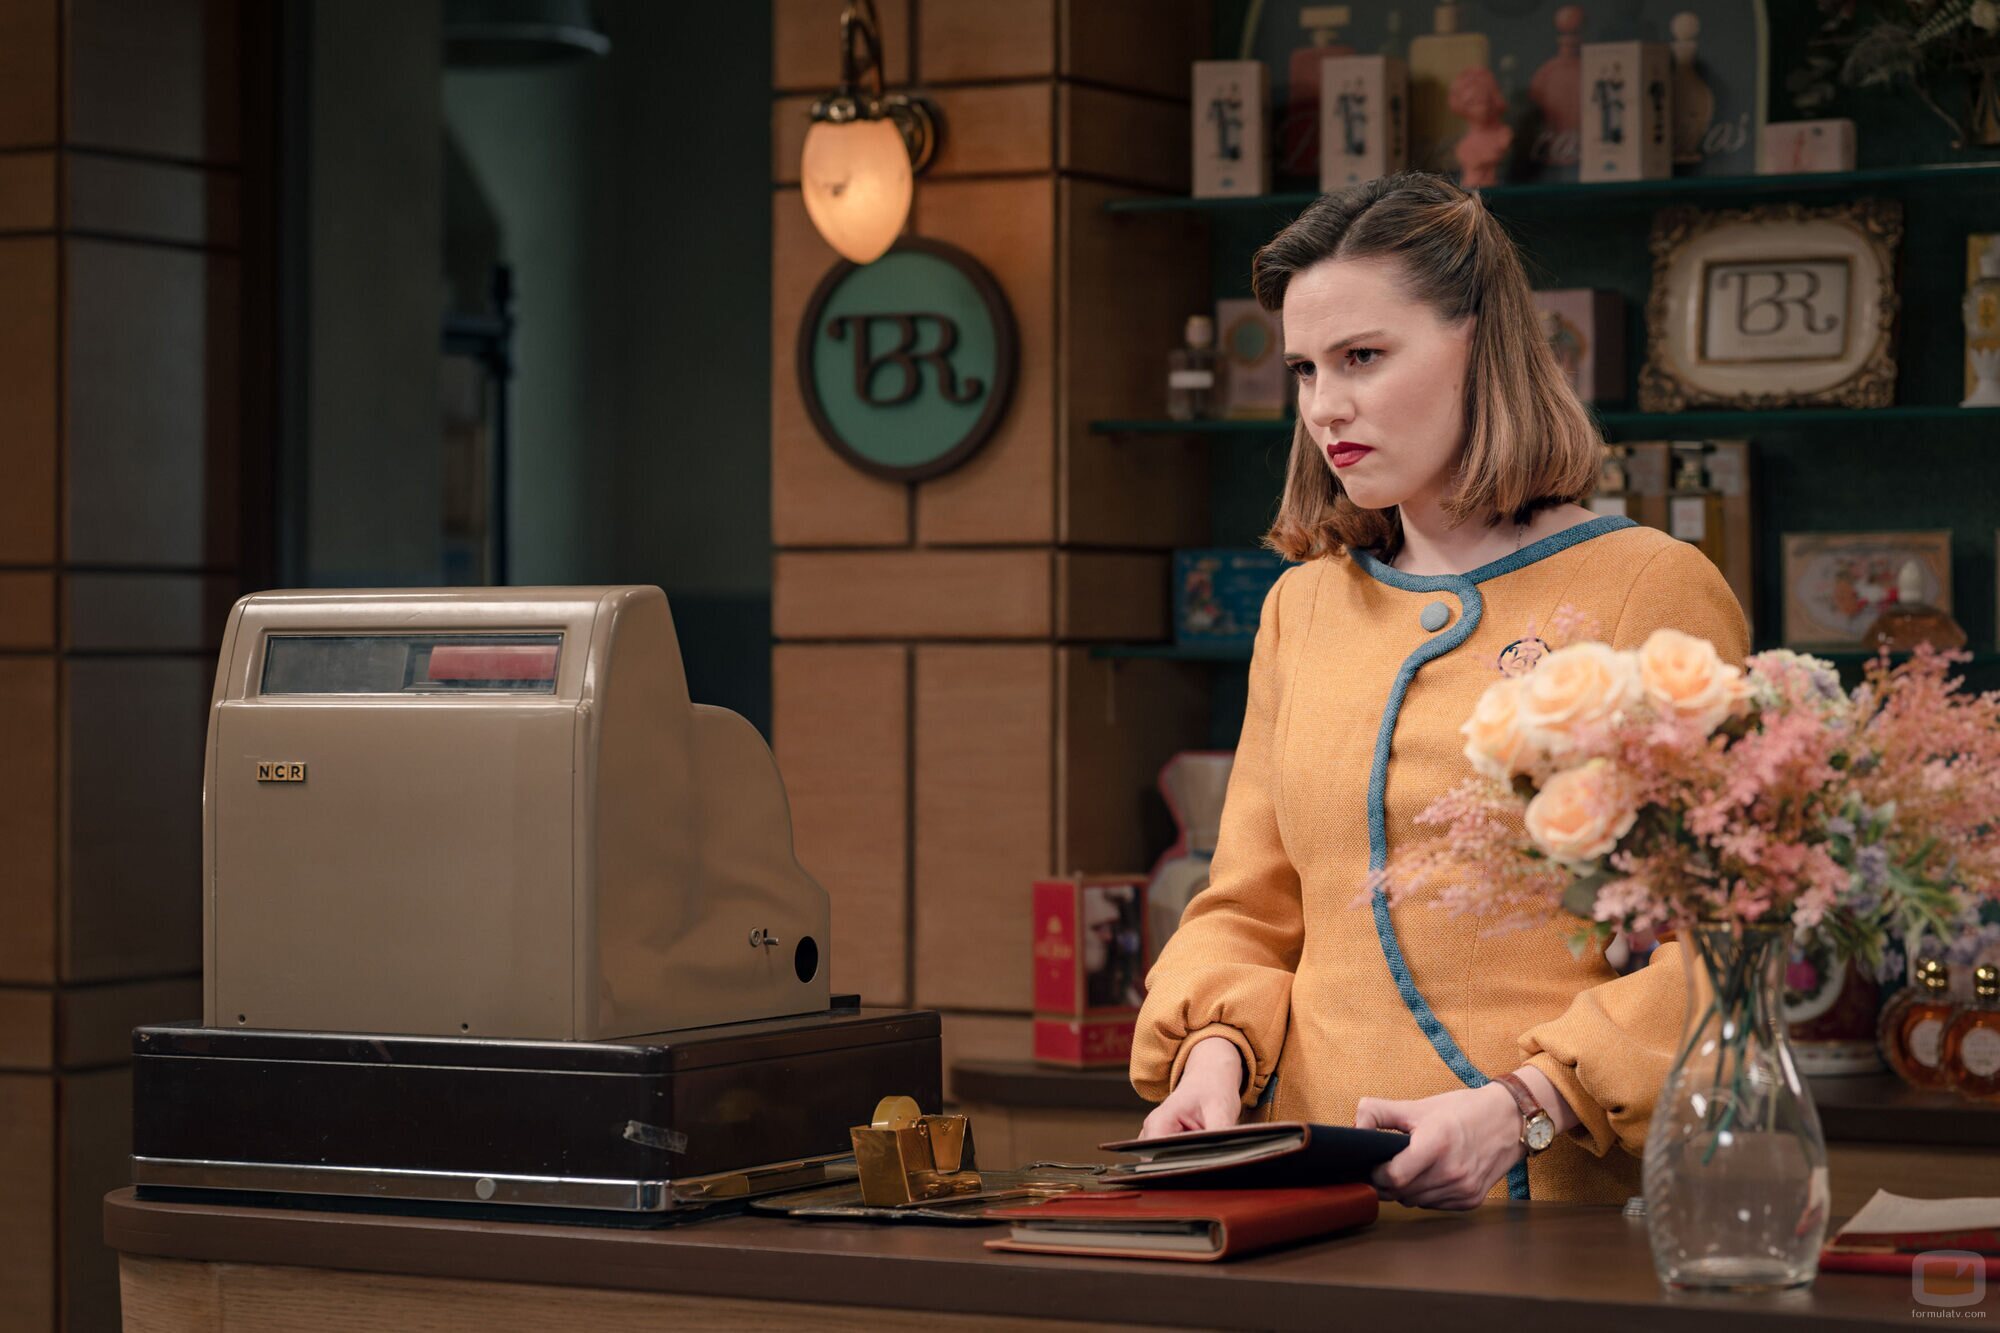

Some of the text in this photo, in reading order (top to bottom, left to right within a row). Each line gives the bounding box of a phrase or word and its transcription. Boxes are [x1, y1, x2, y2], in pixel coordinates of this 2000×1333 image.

[1717, 269, 1840, 337] BR
[827, 313, 985, 408] BR
[258, 765, 301, 778] NCR
